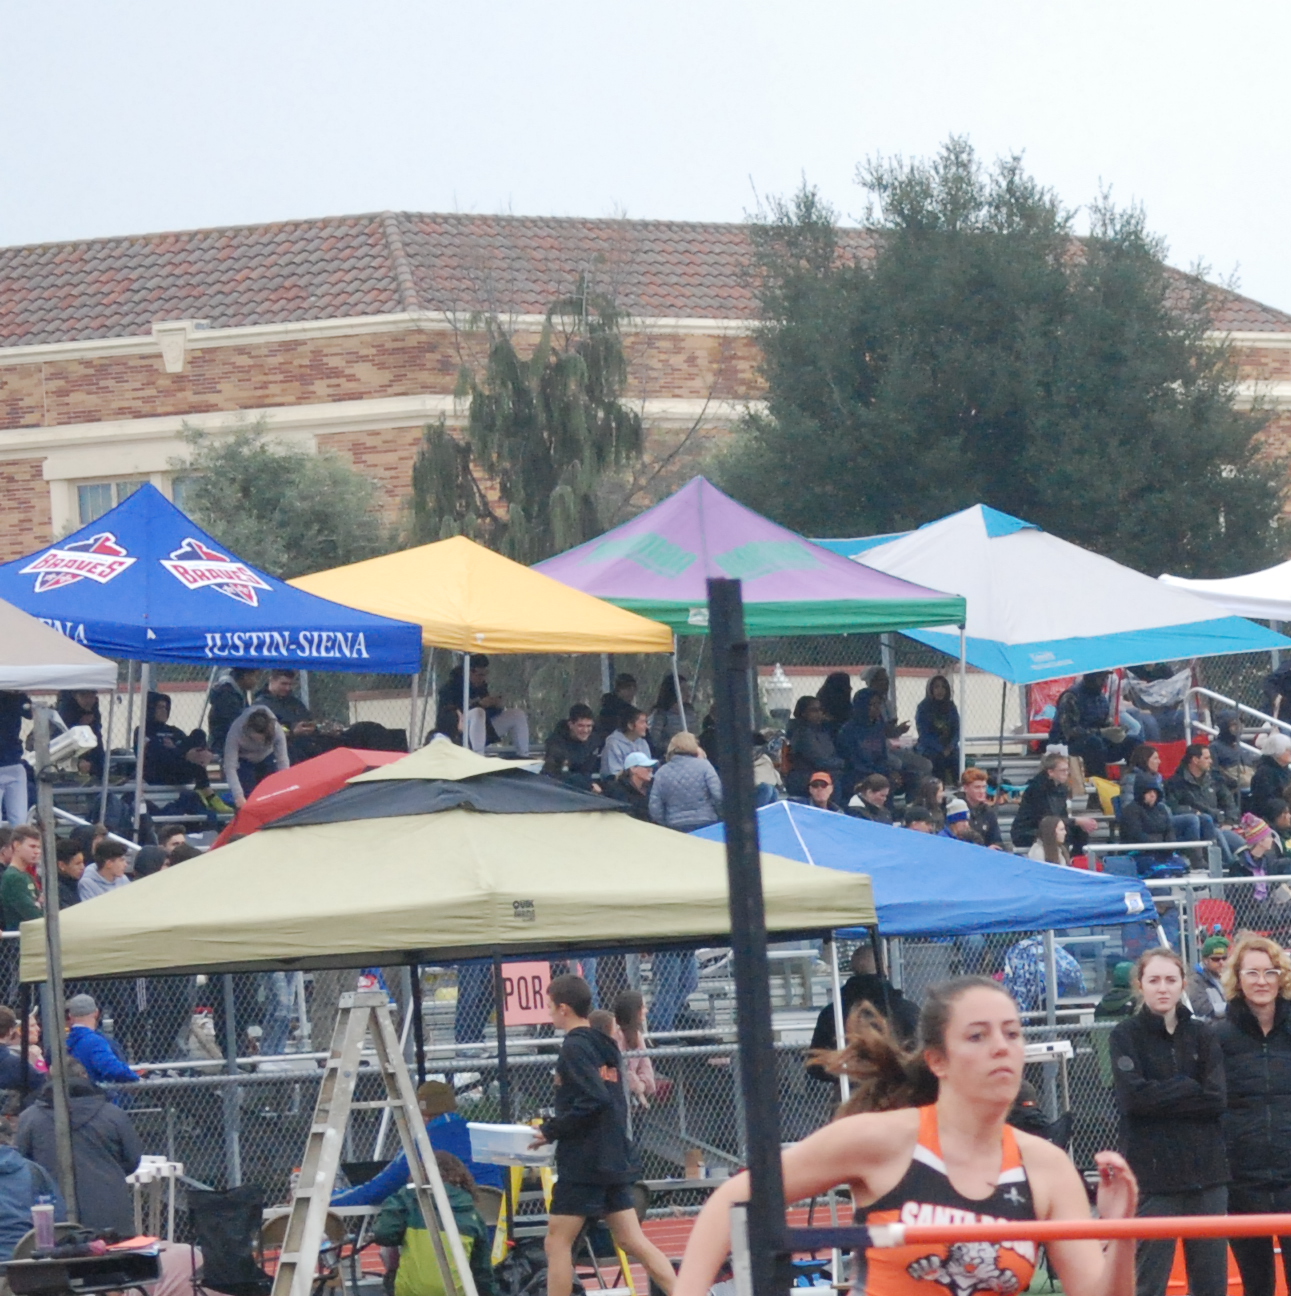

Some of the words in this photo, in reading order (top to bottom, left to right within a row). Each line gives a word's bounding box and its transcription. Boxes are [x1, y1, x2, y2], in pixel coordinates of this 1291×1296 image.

[30, 553, 127, 578] BRAVES
[170, 564, 263, 585] BRAVES
[205, 631, 369, 658] JUSTIN-SIENA
[503, 975, 544, 1011] PQR
